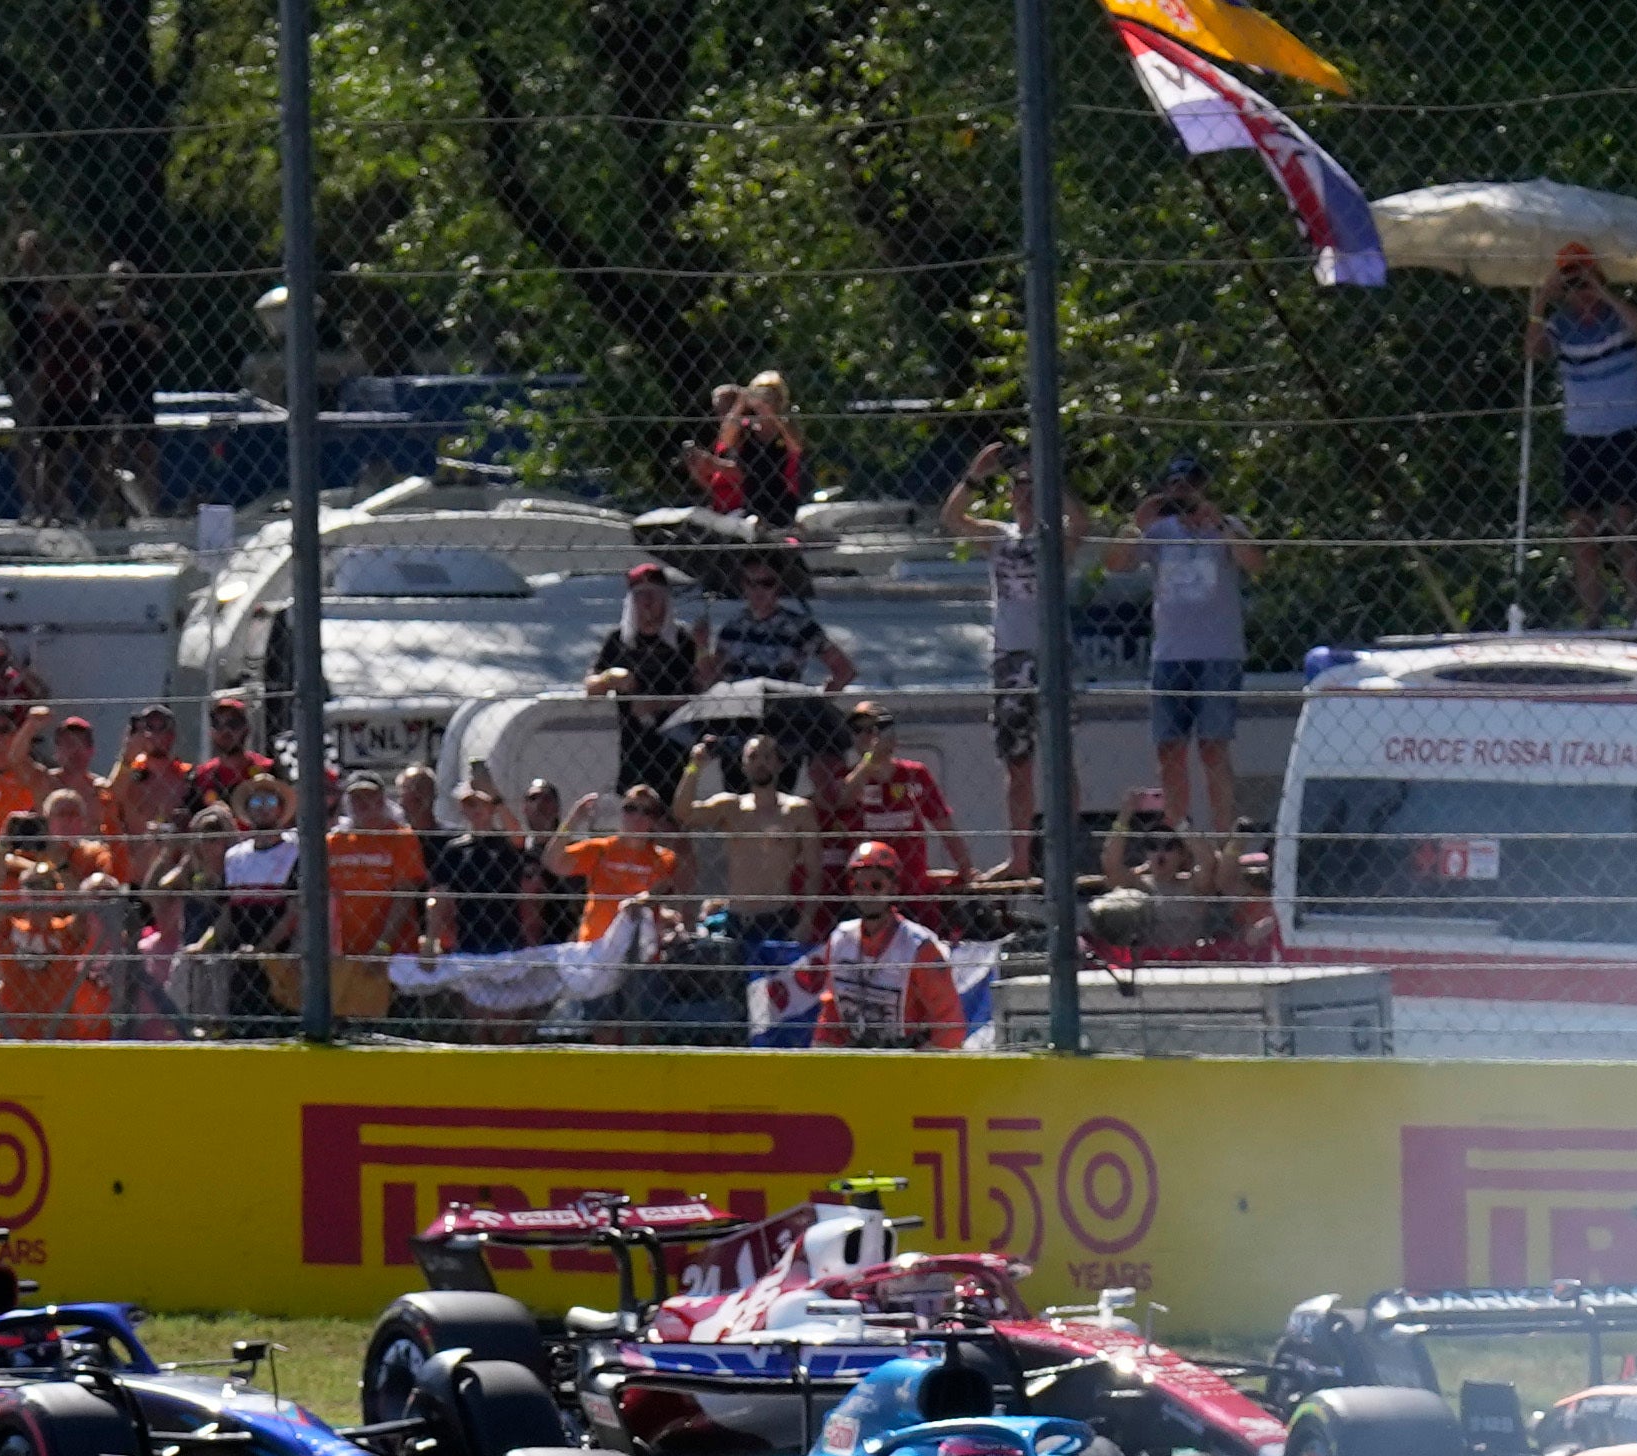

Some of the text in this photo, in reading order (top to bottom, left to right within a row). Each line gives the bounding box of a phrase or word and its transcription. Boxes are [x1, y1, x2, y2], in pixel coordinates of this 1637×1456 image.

[1385, 737, 1465, 765] CROCE
[1473, 738, 1553, 766] ROSSA
[912, 1115, 1159, 1264] 150
[681, 1262, 721, 1299] 24
[1068, 1261, 1152, 1291] YEARS
